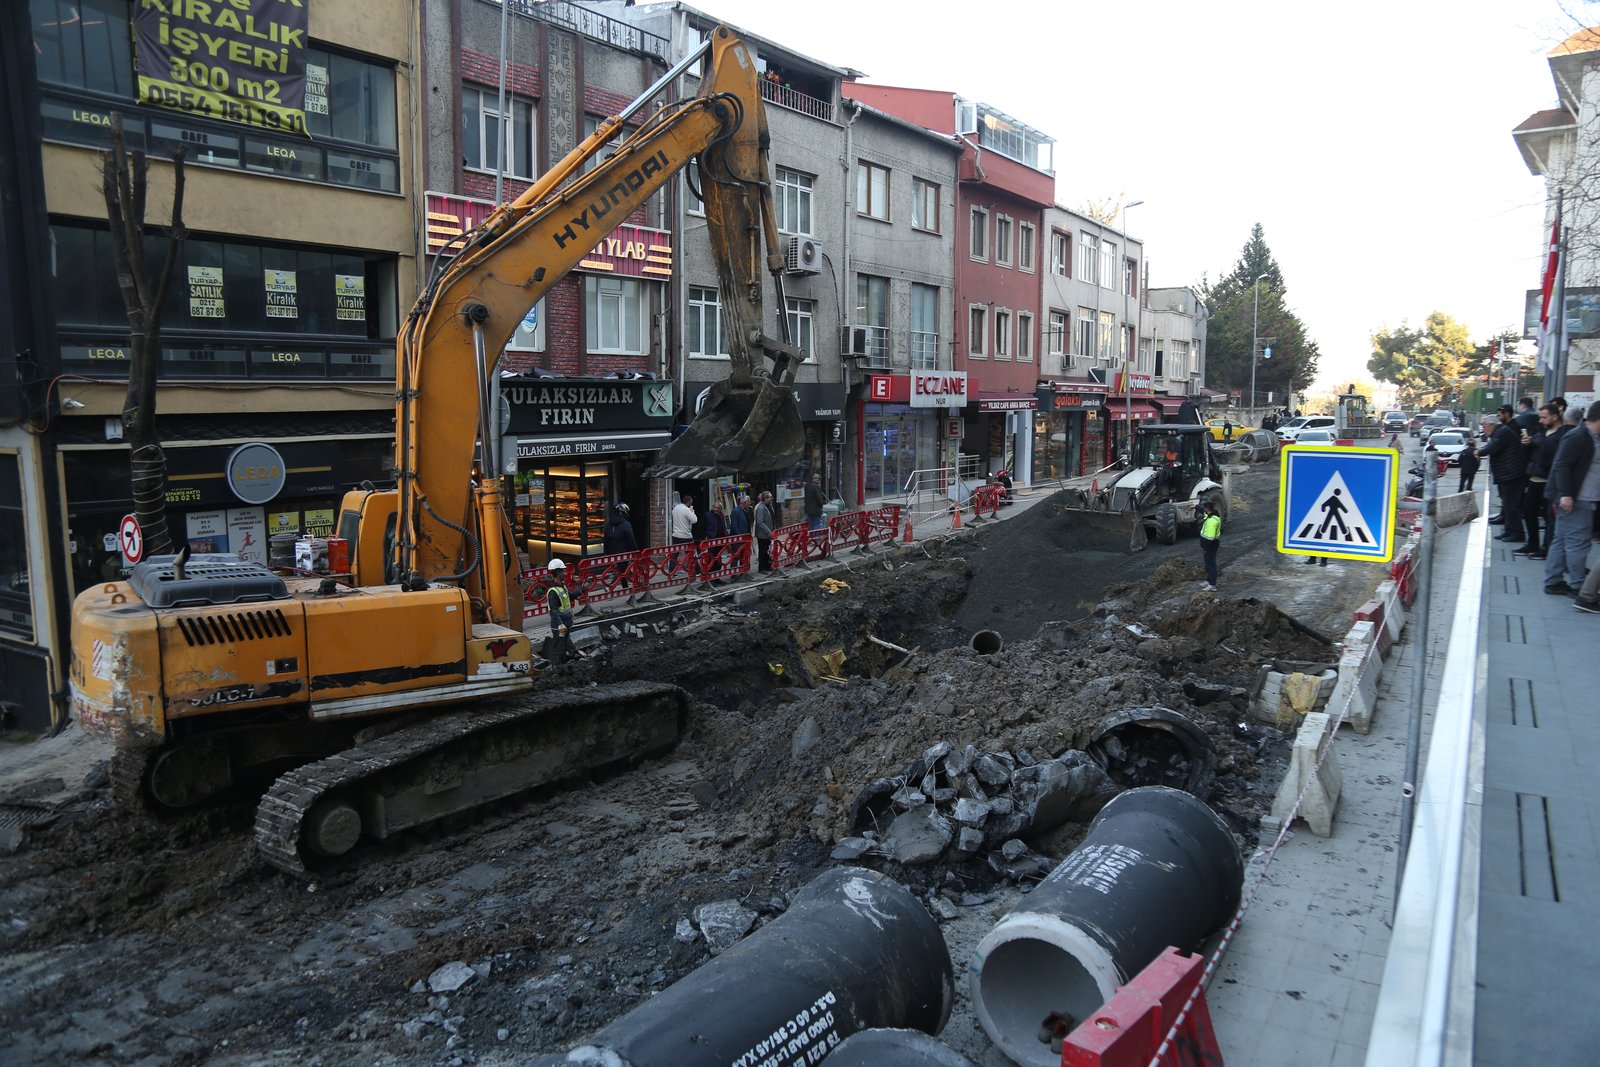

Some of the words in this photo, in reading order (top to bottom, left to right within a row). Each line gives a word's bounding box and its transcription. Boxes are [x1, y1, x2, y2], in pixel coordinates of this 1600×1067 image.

[159, 17, 288, 73] İŞYERİ
[170, 56, 229, 92] 300
[237, 77, 282, 104] m2
[147, 84, 212, 115] 0554
[219, 100, 253, 123] 151
[257, 108, 281, 128] 19
[286, 114, 304, 133] 11
[73, 111, 112, 127] LEQA
[181, 131, 208, 144] CAFE
[267, 146, 297, 159] LEQA
[350, 160, 372, 172] CAFE
[553, 150, 669, 249] HYUNDAI
[191, 285, 223, 298] SATILIK
[267, 292, 296, 306] Kiralık
[337, 296, 364, 309] Kiralık
[192, 307, 204, 316] 687
[206, 307, 215, 316] 87
[88, 348, 125, 360] LEQA
[271, 352, 301, 363] LEQA
[877, 380, 886, 396] E
[916, 376, 965, 395] ECZANE
[1055, 394, 1080, 409] galaksi
[541, 408, 595, 425] FIRIN
[950, 422, 958, 435] E
[575, 443, 597, 453] FIRIN
[236, 465, 280, 481] LEQA
[307, 526, 333, 537] SATILIK
